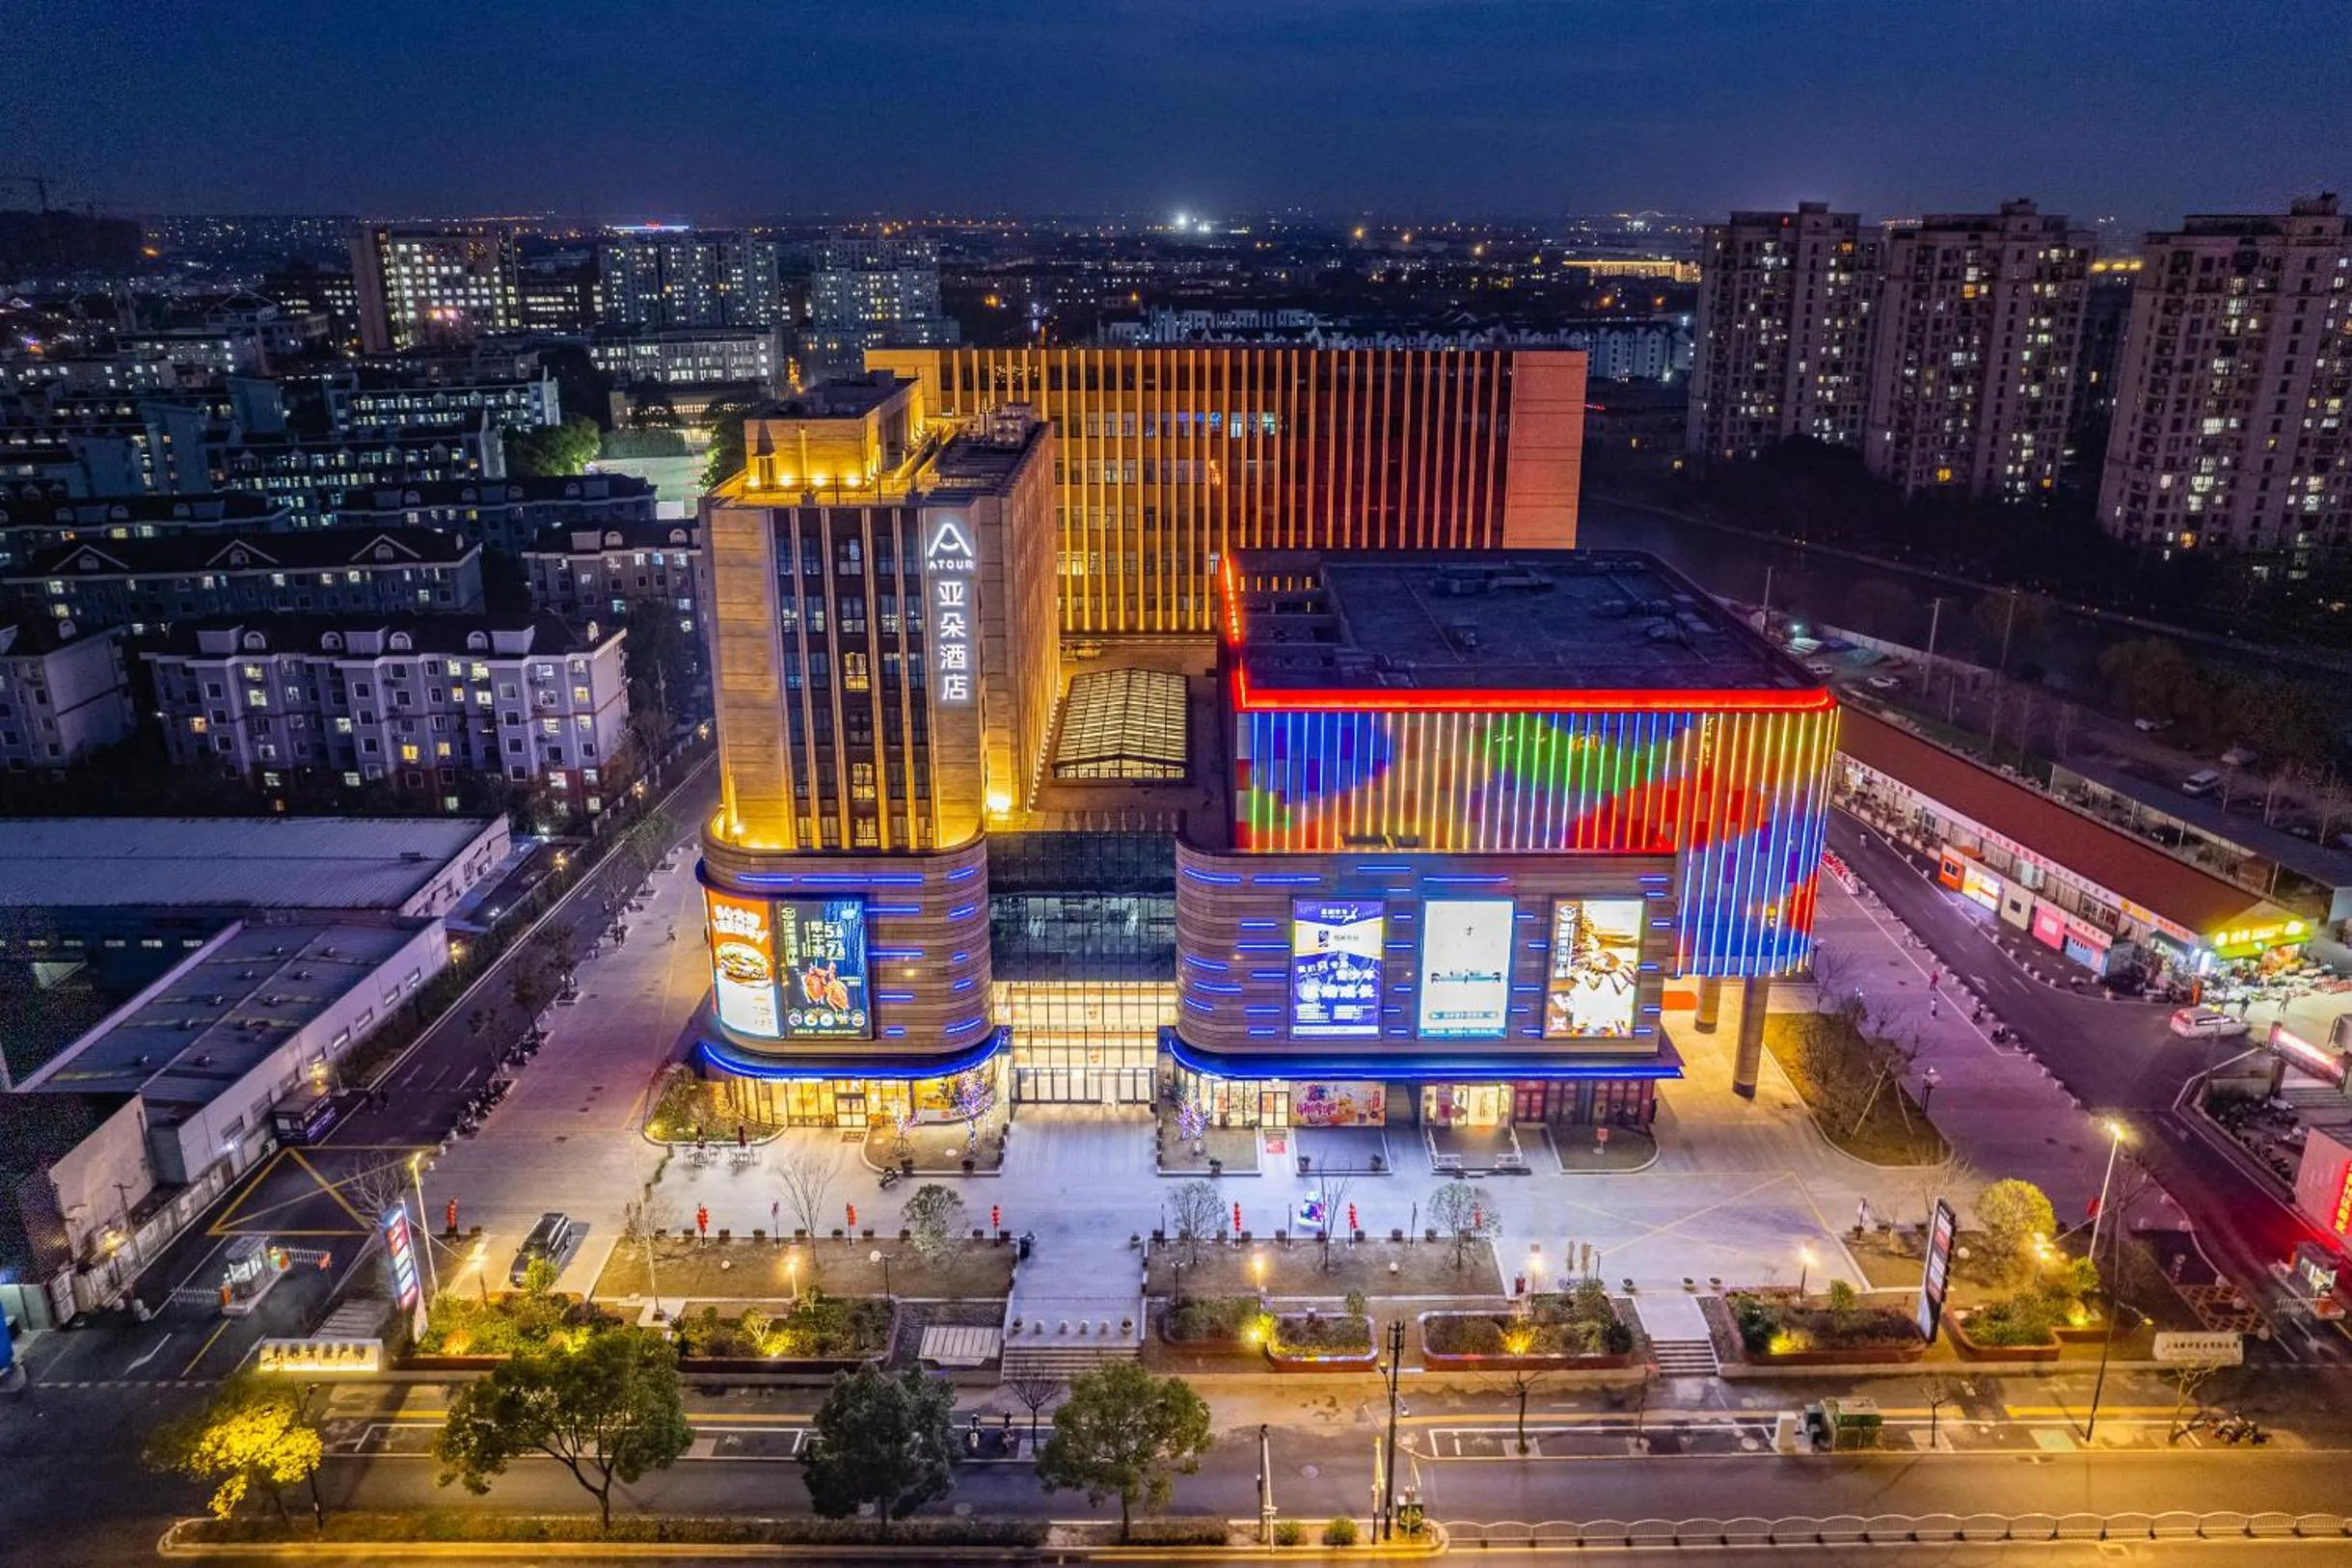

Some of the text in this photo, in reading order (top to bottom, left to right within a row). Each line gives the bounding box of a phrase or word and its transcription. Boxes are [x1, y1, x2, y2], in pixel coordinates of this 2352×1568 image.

[929, 559, 974, 570] ATOUR
[937, 581, 967, 701] 亚朵酒店
